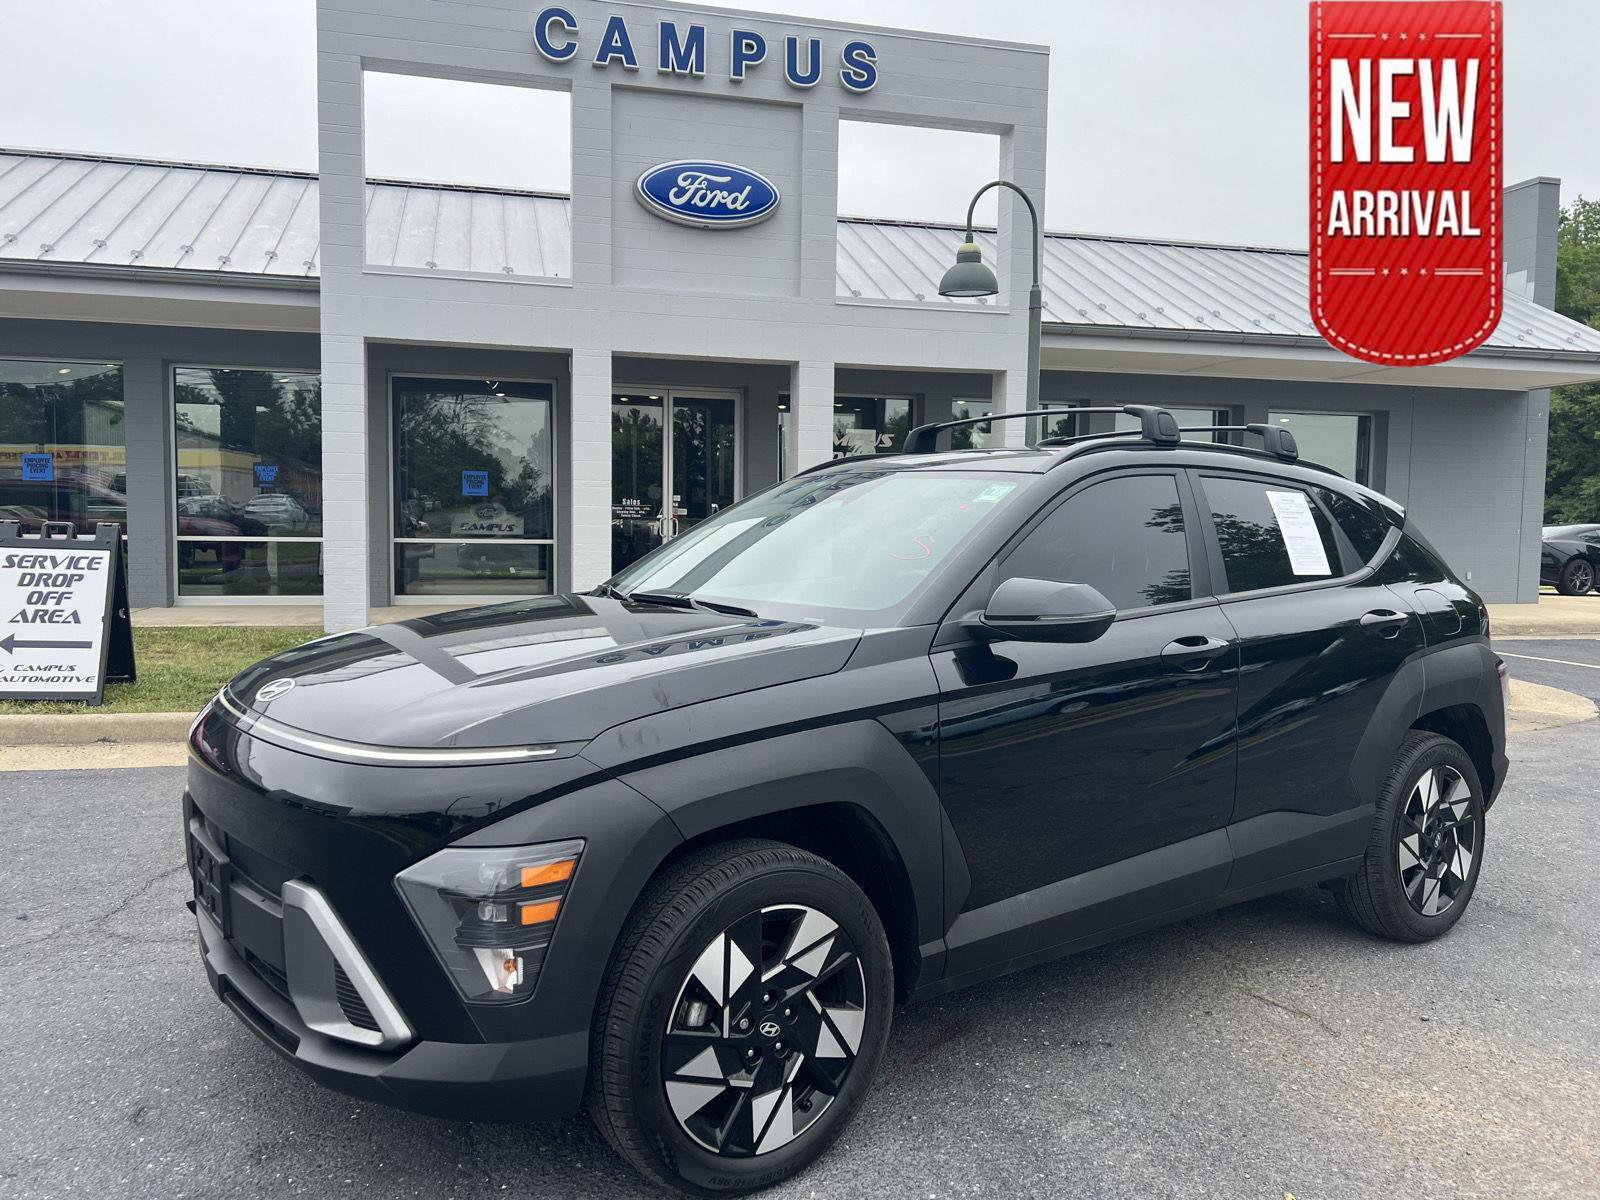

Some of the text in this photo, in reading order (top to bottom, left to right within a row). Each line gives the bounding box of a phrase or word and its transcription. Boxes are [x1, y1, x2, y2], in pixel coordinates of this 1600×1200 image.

[533, 6, 879, 94] CAMPUS
[667, 171, 752, 211] Ford
[460, 522, 515, 532] CAMPUS
[2, 554, 103, 571] SERVICE
[17, 572, 85, 588] DROP
[26, 591, 73, 606] OFF
[8, 609, 81, 624] AREA
[13, 664, 77, 672] CAMPUS
